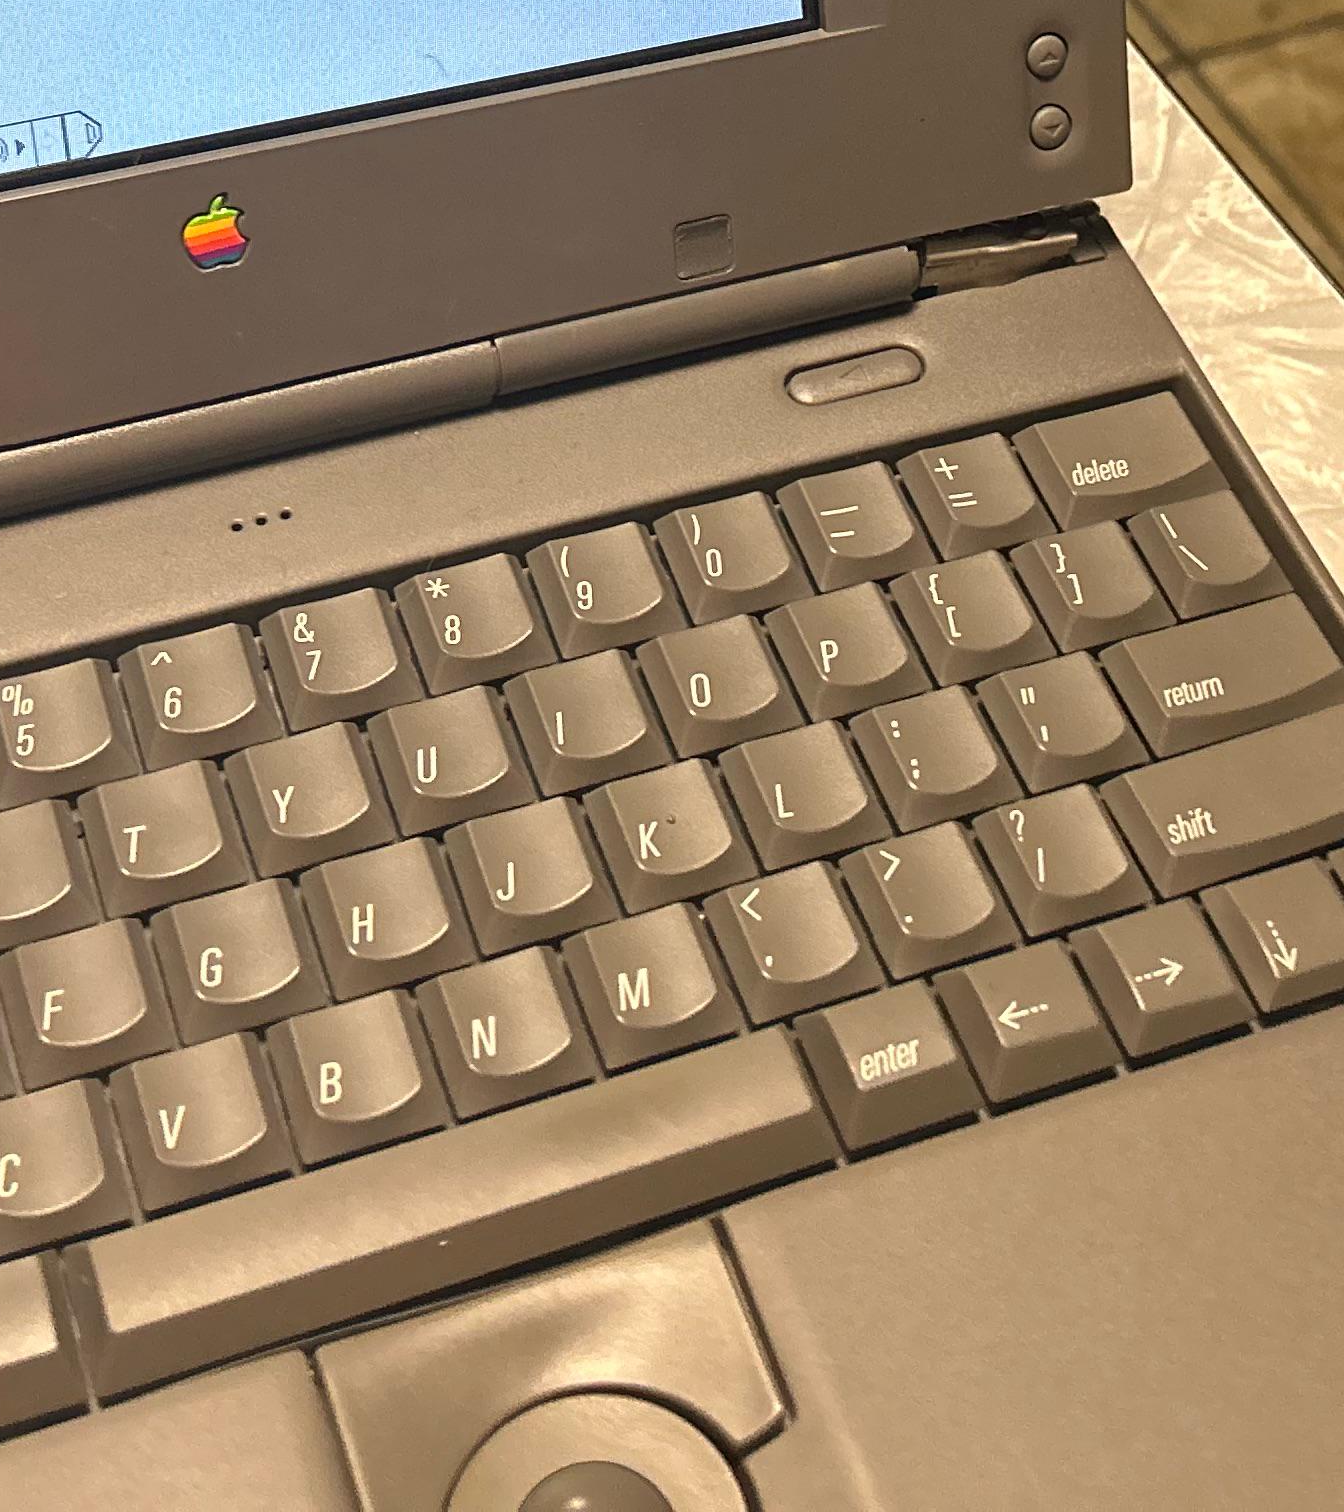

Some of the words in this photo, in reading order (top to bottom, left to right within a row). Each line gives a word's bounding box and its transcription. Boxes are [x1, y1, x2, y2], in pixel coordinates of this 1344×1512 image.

[934, 458, 958, 480] +
[1072, 458, 1129, 485] delete
[576, 580, 593, 610] 9
[293, 613, 315, 642] &
[444, 615, 461, 645] 8
[305, 650, 322, 680] 7
[820, 640, 838, 673] P
[1, 684, 33, 716] %
[164, 687, 182, 718] 6
[1163, 676, 1225, 707] return
[16, 724, 35, 756] 5
[417, 746, 436, 784] U
[272, 785, 294, 823] Y
[775, 784, 794, 818] L
[638, 821, 661, 860] K
[1009, 809, 1026, 842] ?
[1166, 810, 1217, 844] shift
[123, 825, 146, 863] T
[495, 861, 515, 901] J
[352, 904, 374, 944] H
[199, 947, 223, 988] G
[617, 968, 650, 1010] M
[43, 990, 64, 1031] F
[471, 1015, 496, 1059] N
[859, 1039, 920, 1081] enter
[320, 1062, 342, 1104] B
[158, 1106, 185, 1149] V
